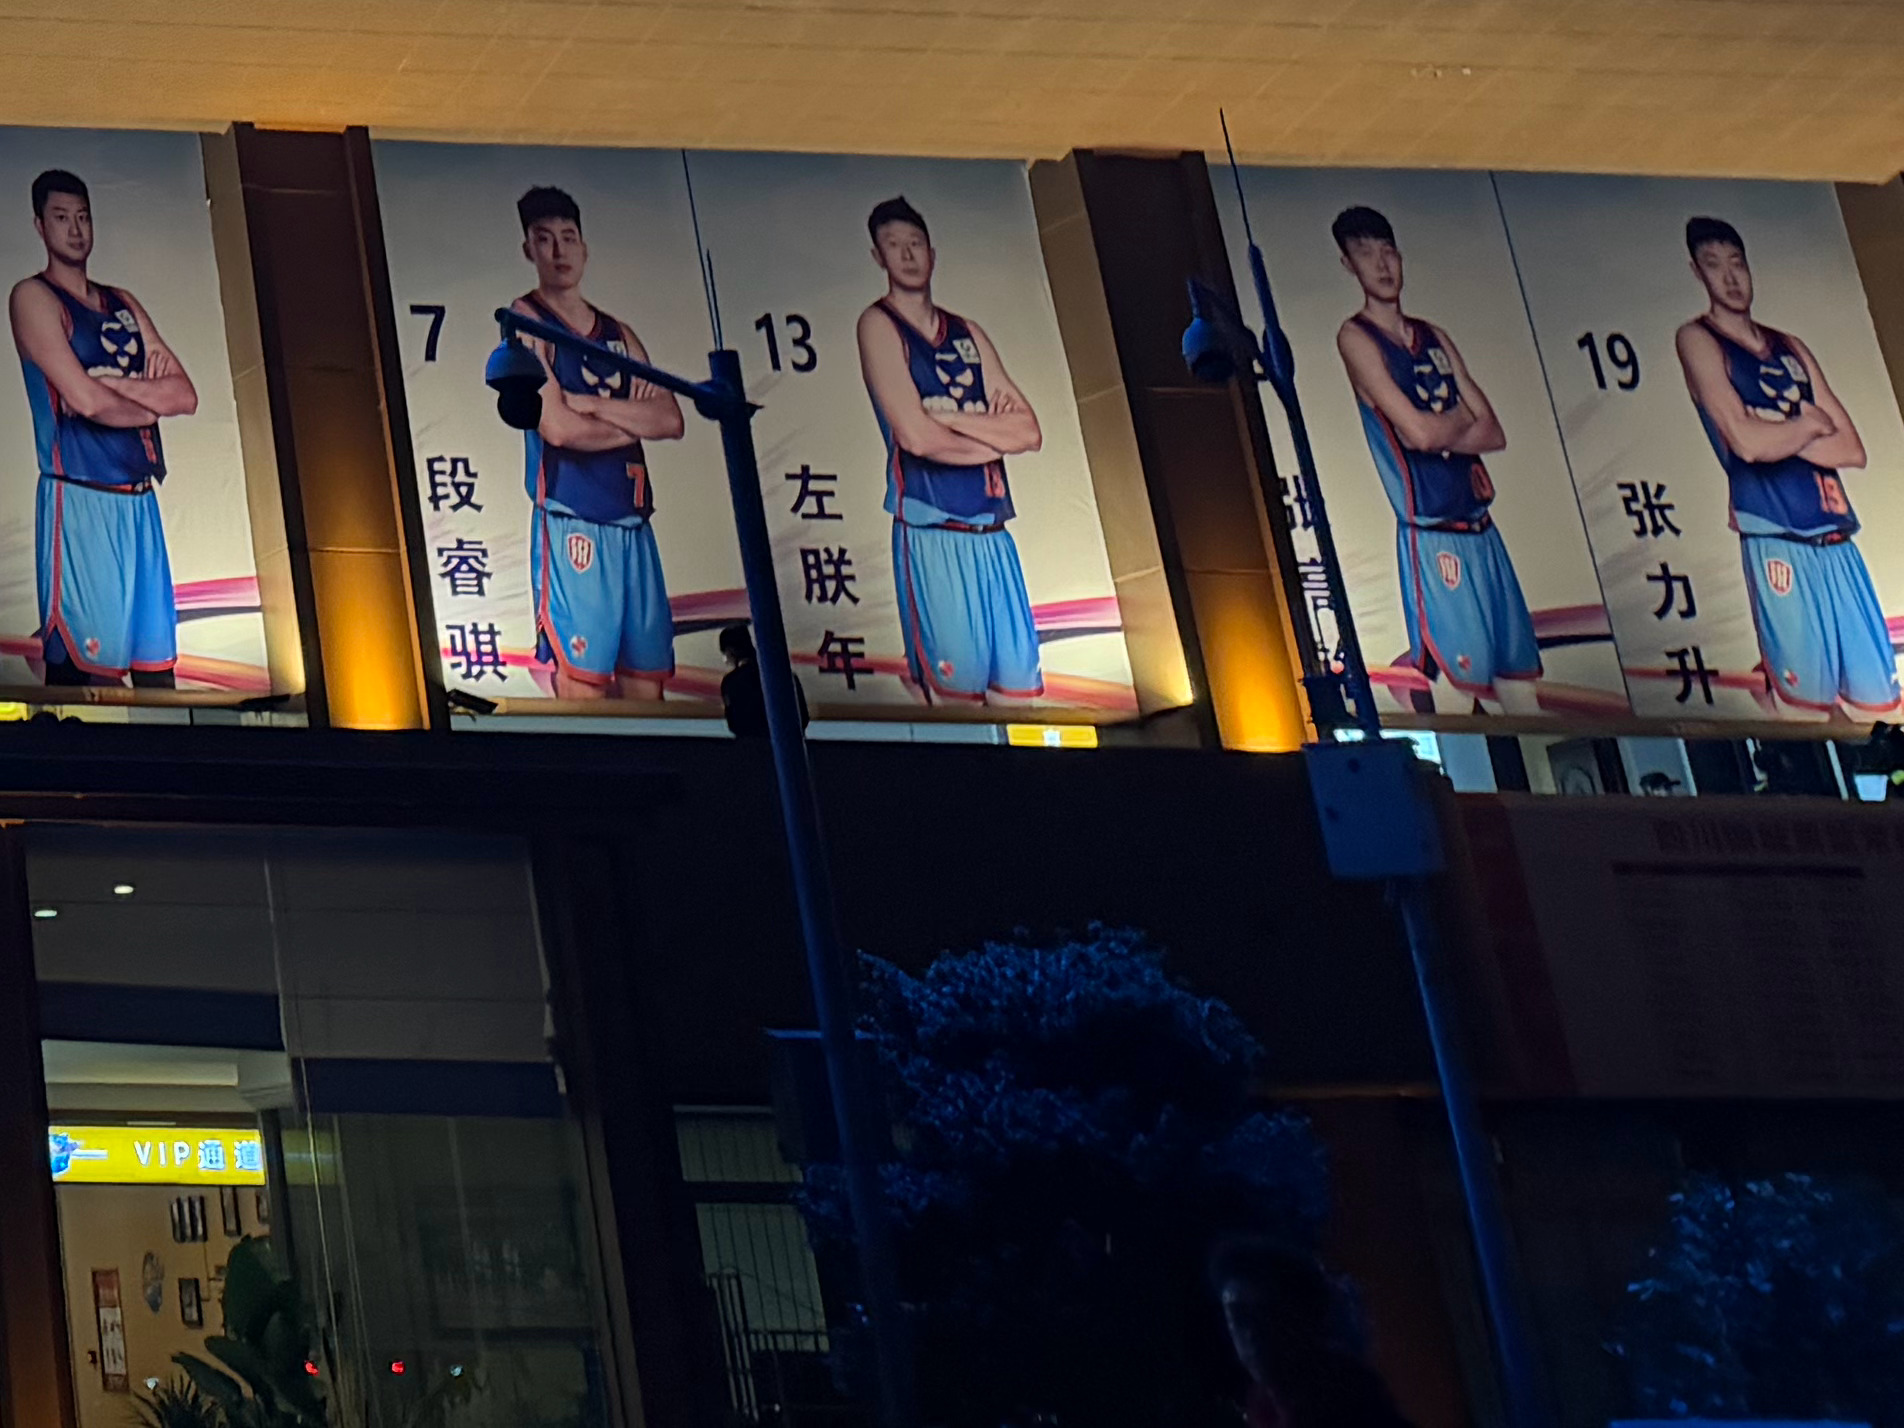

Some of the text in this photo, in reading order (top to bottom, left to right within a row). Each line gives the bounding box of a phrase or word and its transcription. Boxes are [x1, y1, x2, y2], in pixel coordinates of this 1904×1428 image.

[409, 305, 446, 362] 7
[754, 312, 818, 373] 13
[1577, 331, 1641, 392] 19
[625, 462, 644, 508] 7
[426, 454, 509, 682] 段睿骐
[785, 465, 874, 691] 左朕年
[1617, 480, 1719, 706] 张力升
